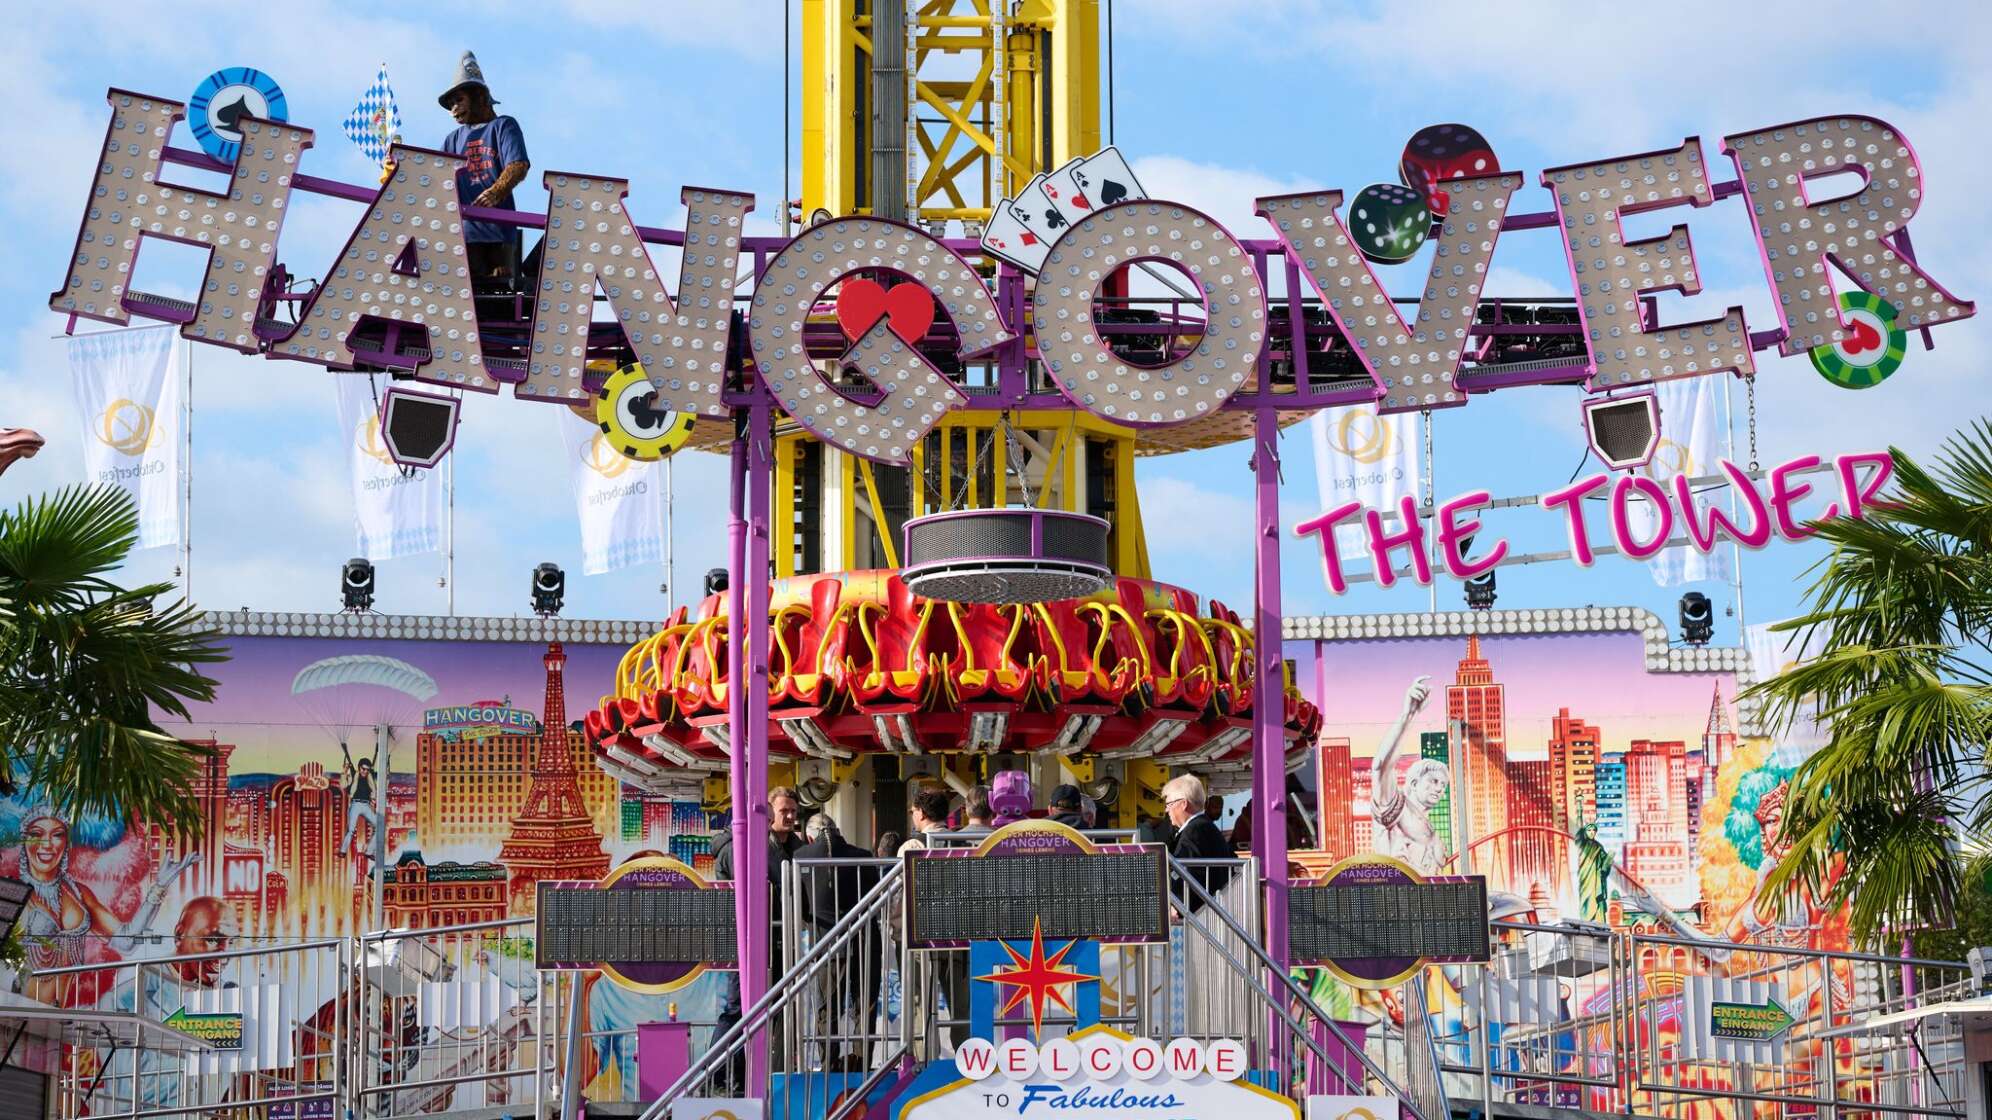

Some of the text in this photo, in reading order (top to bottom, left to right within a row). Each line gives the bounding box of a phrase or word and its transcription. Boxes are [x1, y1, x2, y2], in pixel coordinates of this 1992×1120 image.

[1076, 171, 1086, 180] A
[1045, 183, 1055, 194] A
[1014, 207, 1024, 217] A
[988, 236, 998, 246] A
[50, 86, 1975, 463] HANGOVER
[1295, 451, 1906, 596] THE TOWER
[426, 707, 534, 728] HANGOVER
[1001, 837, 1071, 848] HANGOVER
[228, 859, 260, 892] NO
[624, 873, 686, 882] HANGOVER
[1341, 869, 1401, 879] HANGOVER
[1712, 1006, 1786, 1022] ENTRANCE
[168, 1018, 242, 1030] ENTRANCE
[1721, 1018, 1776, 1031] EINGANG
[186, 1029, 241, 1039] INGANG
[962, 1047, 1235, 1072] WELCOME
[983, 1084, 1185, 1115] TO Fabulous
